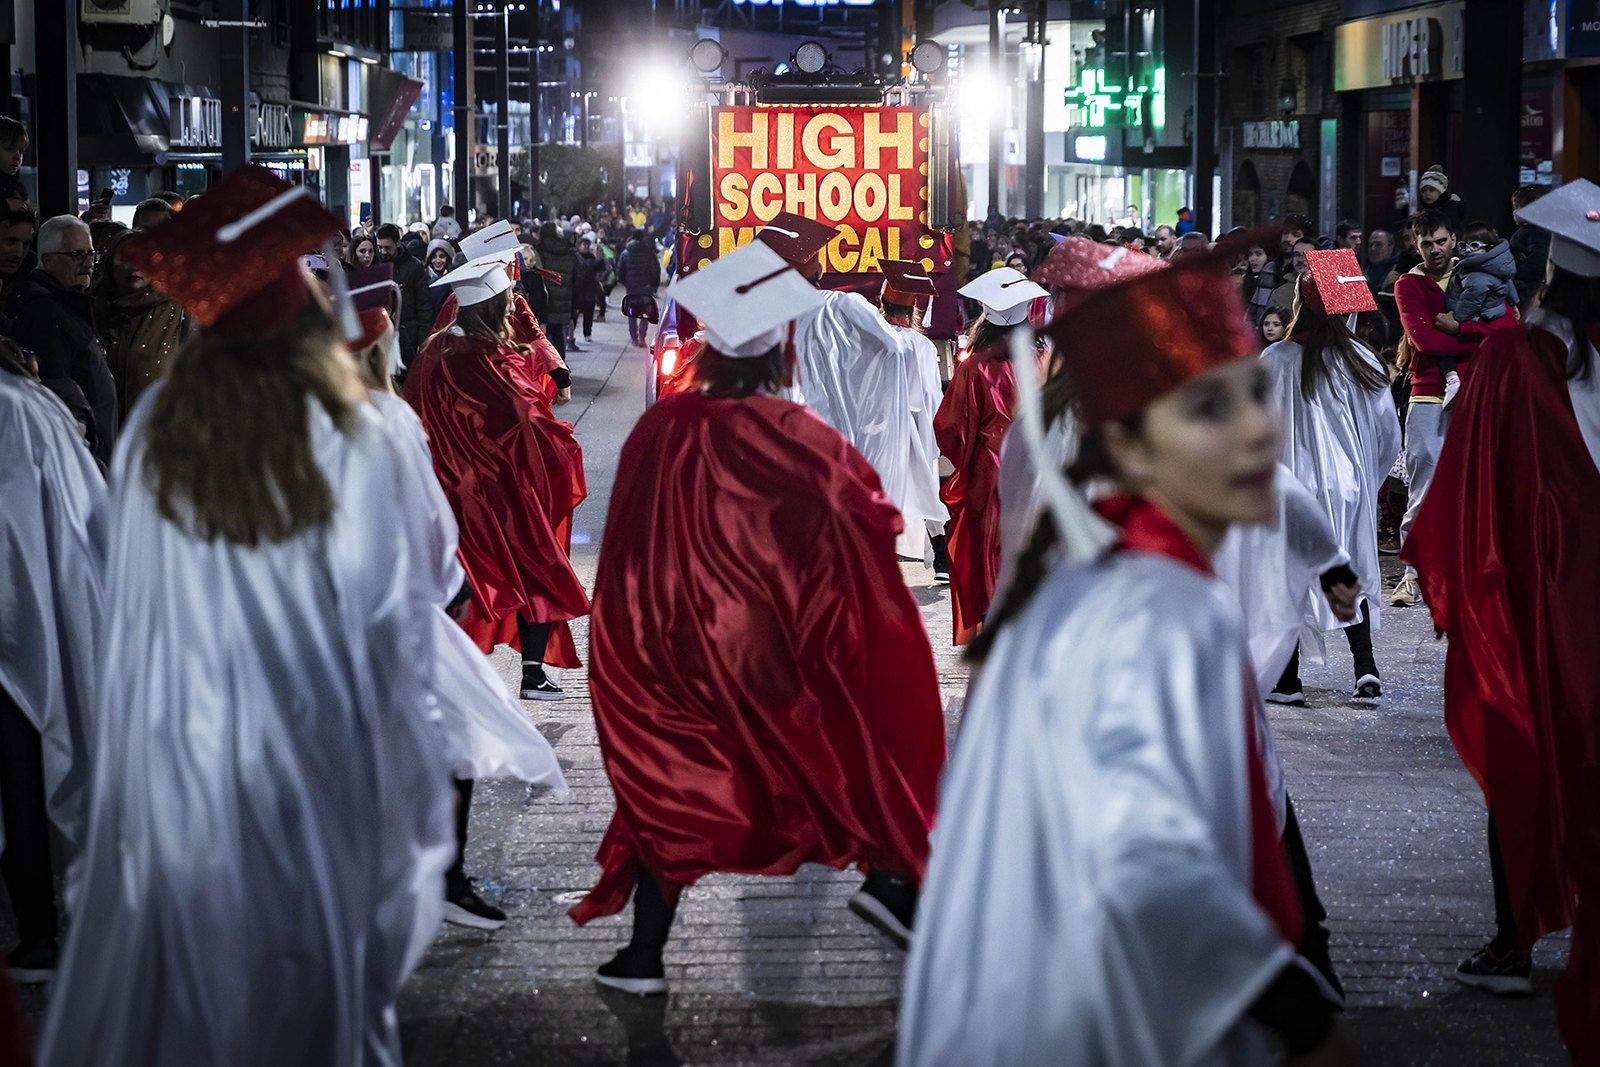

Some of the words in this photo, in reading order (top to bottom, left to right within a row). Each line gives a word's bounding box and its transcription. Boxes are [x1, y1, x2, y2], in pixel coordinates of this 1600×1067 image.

[1382, 17, 1429, 79] HIPER
[718, 112, 914, 170] HIGH
[719, 171, 914, 222] SCHOOL
